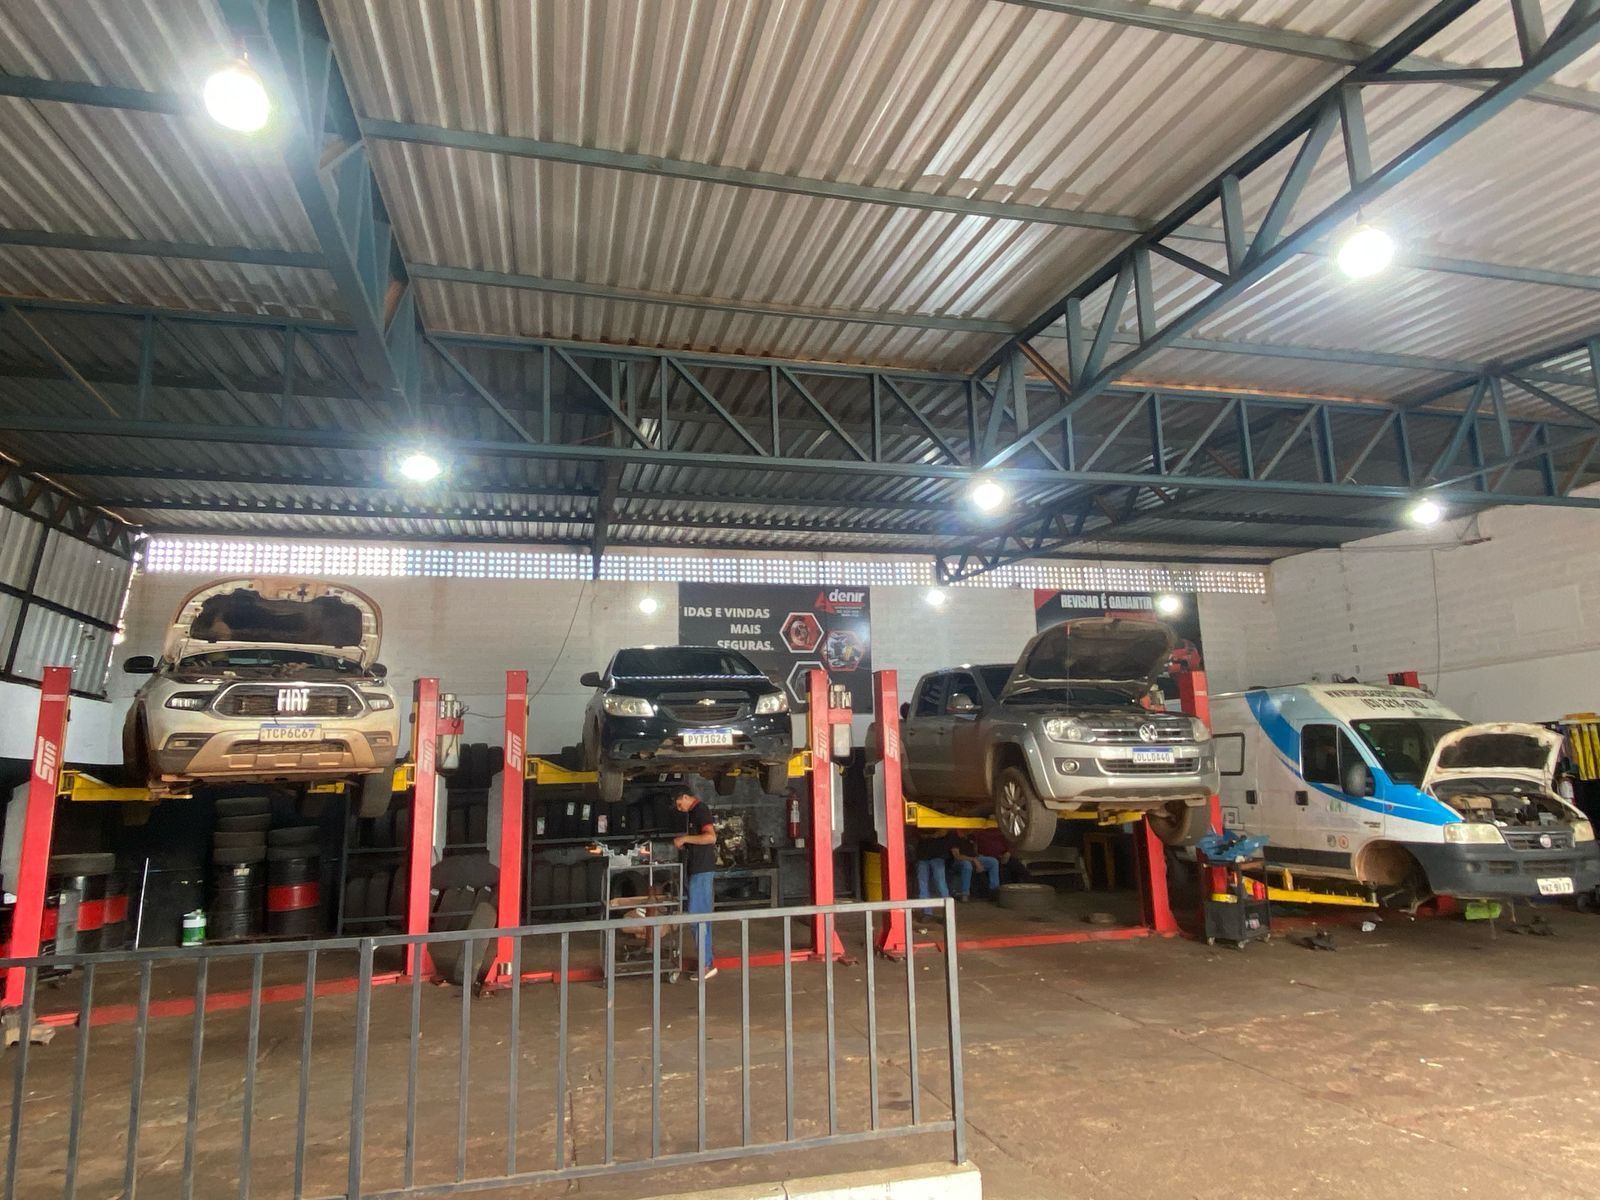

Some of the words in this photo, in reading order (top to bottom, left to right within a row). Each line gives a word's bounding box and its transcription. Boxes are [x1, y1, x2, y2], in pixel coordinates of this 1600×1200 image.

[1060, 594, 1100, 608] REVISAR
[1101, 593, 1108, 609] É
[1108, 596, 1152, 609] GARANTIR
[683, 606, 712, 617] IDAS
[715, 607, 721, 617] E
[723, 607, 770, 619] VINDAS
[730, 624, 761, 634] MAIS
[717, 640, 774, 651] SEGURAS.
[277, 688, 310, 711] FIAT
[266, 729, 315, 738] TCP6C67
[688, 734, 727, 744] PYT1G26
